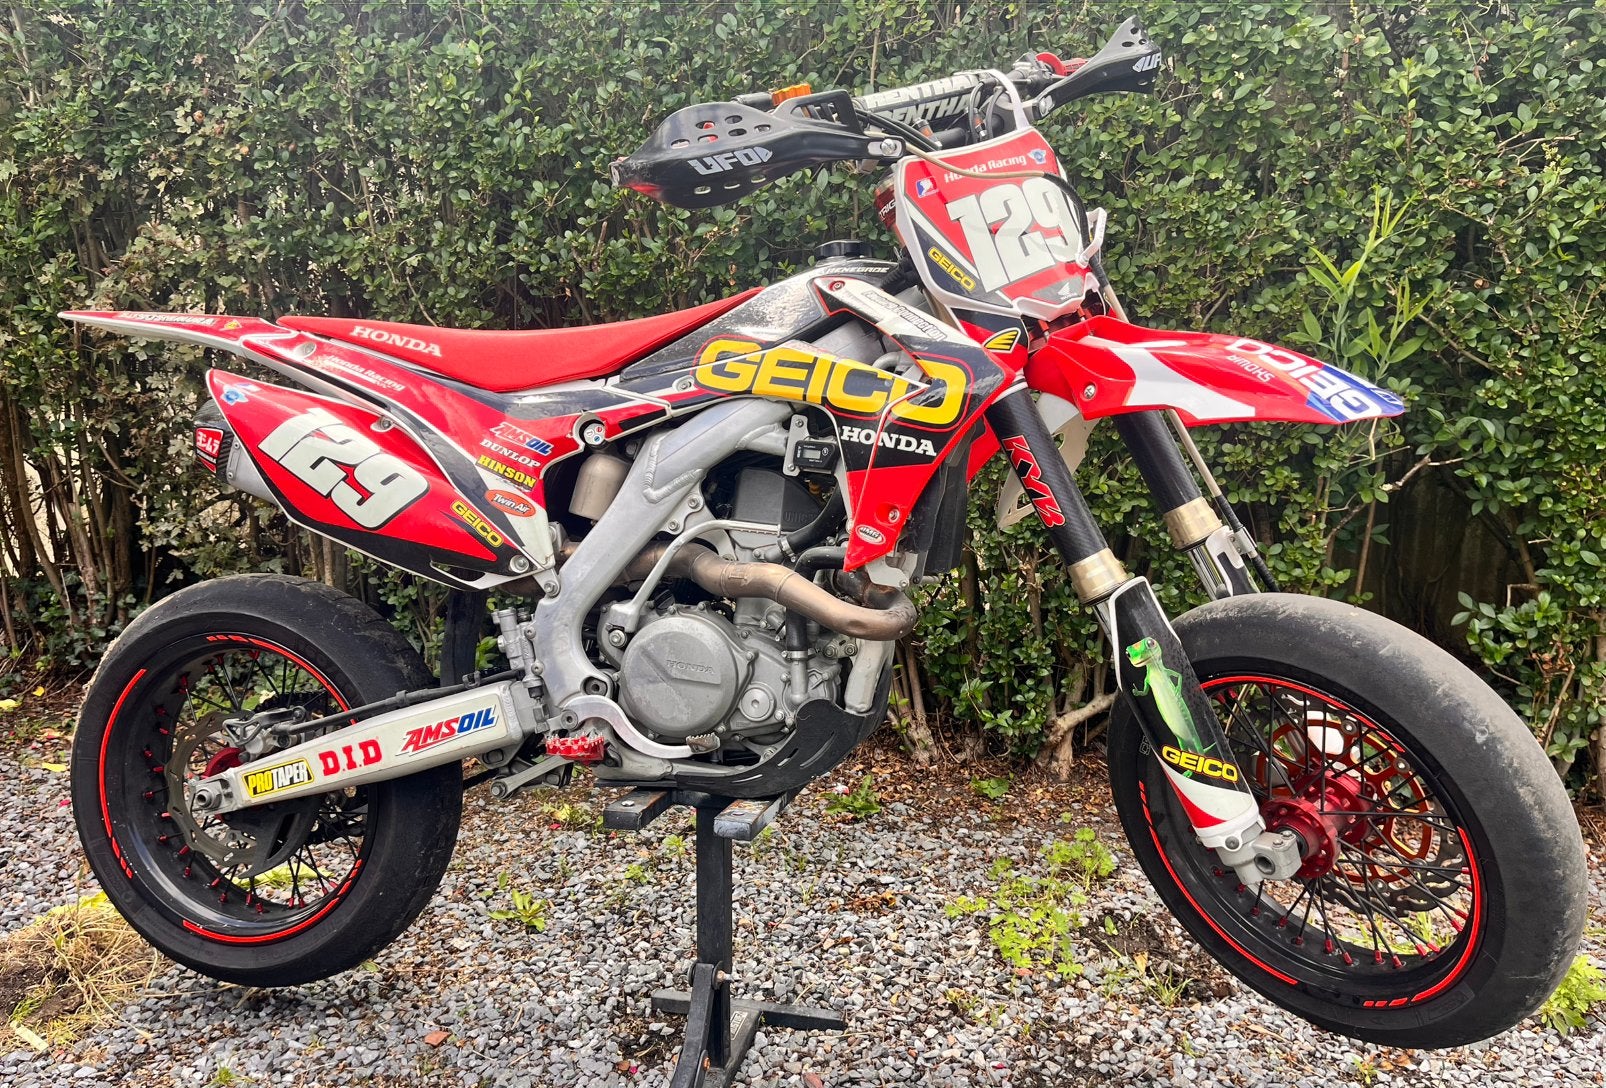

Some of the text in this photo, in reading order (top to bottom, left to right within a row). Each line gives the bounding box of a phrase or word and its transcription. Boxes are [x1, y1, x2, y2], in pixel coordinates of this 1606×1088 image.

[687, 148, 762, 175] UFO
[987, 155, 1027, 171] Racing
[946, 177, 1081, 293] 129
[928, 246, 977, 292] GEICO
[350, 325, 442, 357] HONDA
[696, 339, 967, 425] GEICO
[1225, 338, 1383, 420] GEICO
[1226, 354, 1275, 383] SHOWA
[480, 438, 541, 468] DUNLOP
[490, 421, 554, 456] AMSOIL
[840, 425, 937, 457] HONDA
[257, 407, 431, 531] 129
[477, 454, 538, 489] HINSON
[1001, 434, 1066, 528] KYB
[493, 493, 531, 514] Twin Air
[450, 500, 504, 548] GEICO
[666, 659, 716, 674] HONDA
[397, 705, 498, 755] AMSOIL
[318, 738, 382, 776] D.I.D
[1162, 745, 1238, 782] GEICO
